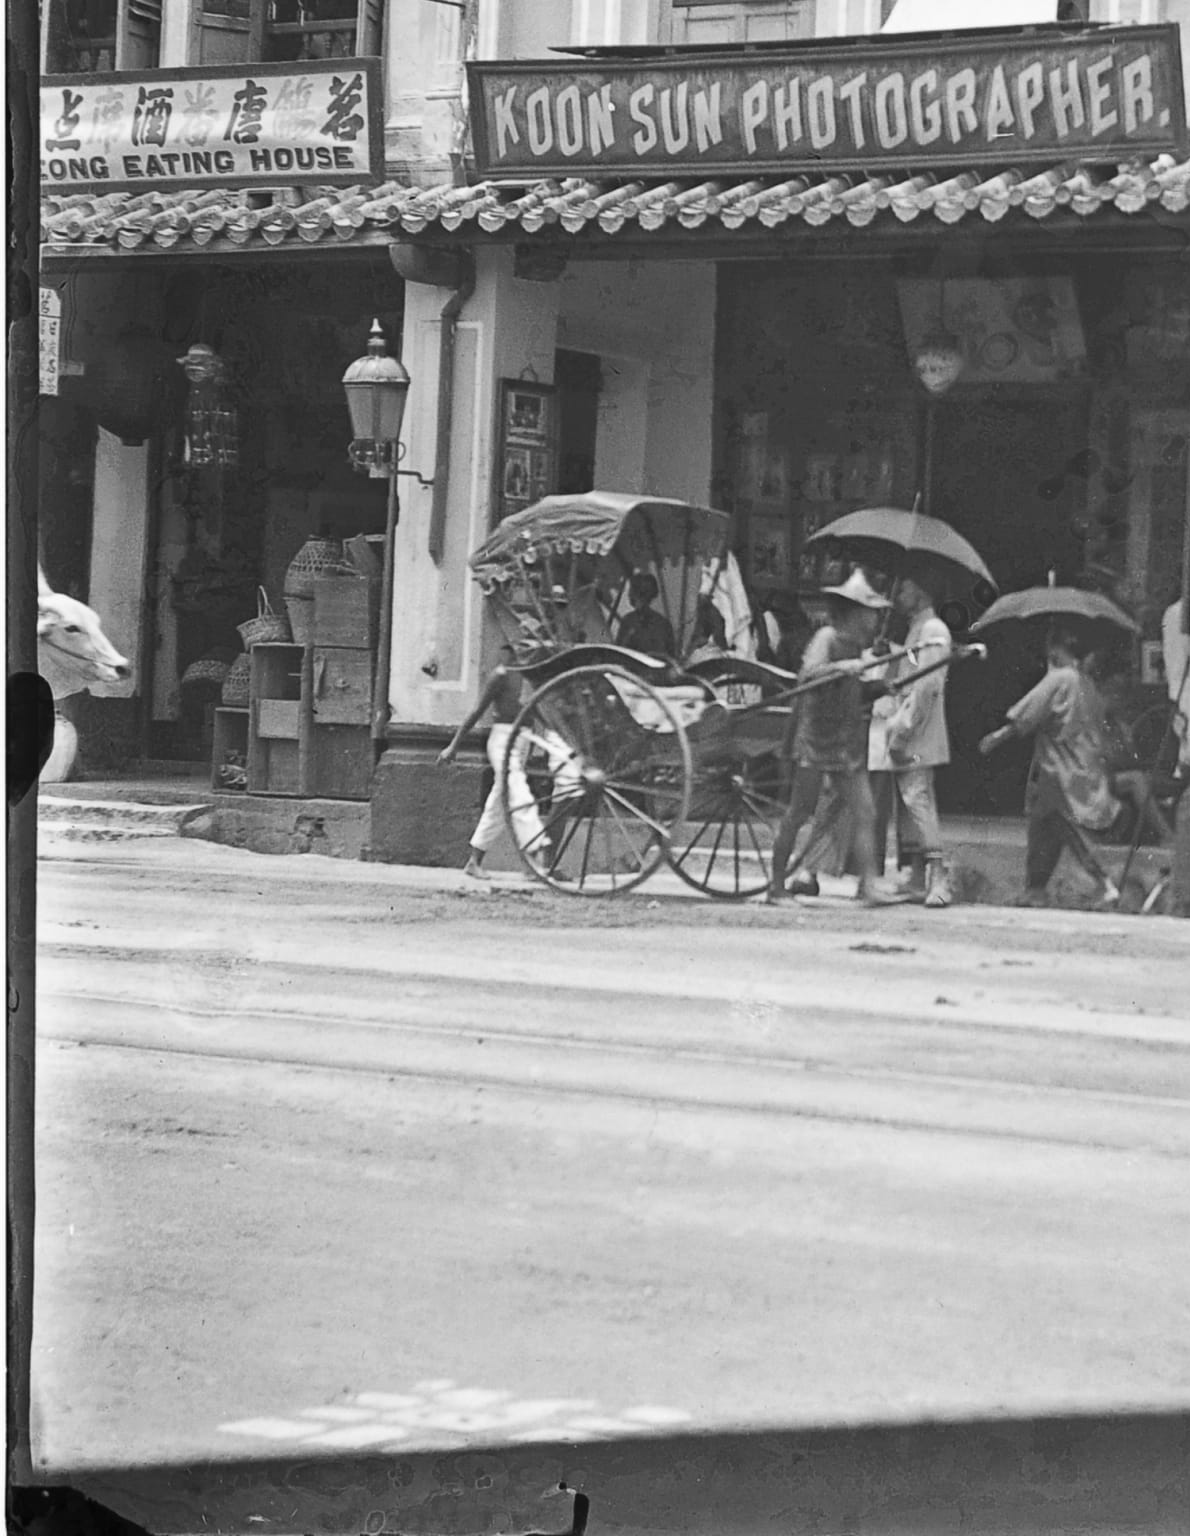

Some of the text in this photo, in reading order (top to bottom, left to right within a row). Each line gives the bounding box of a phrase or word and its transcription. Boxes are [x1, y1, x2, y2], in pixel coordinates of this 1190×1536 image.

[498, 54, 1170, 157] KOON SUN PHOTOGRAPHER.
[41, 145, 355, 180] ONG EATING HOUSE
